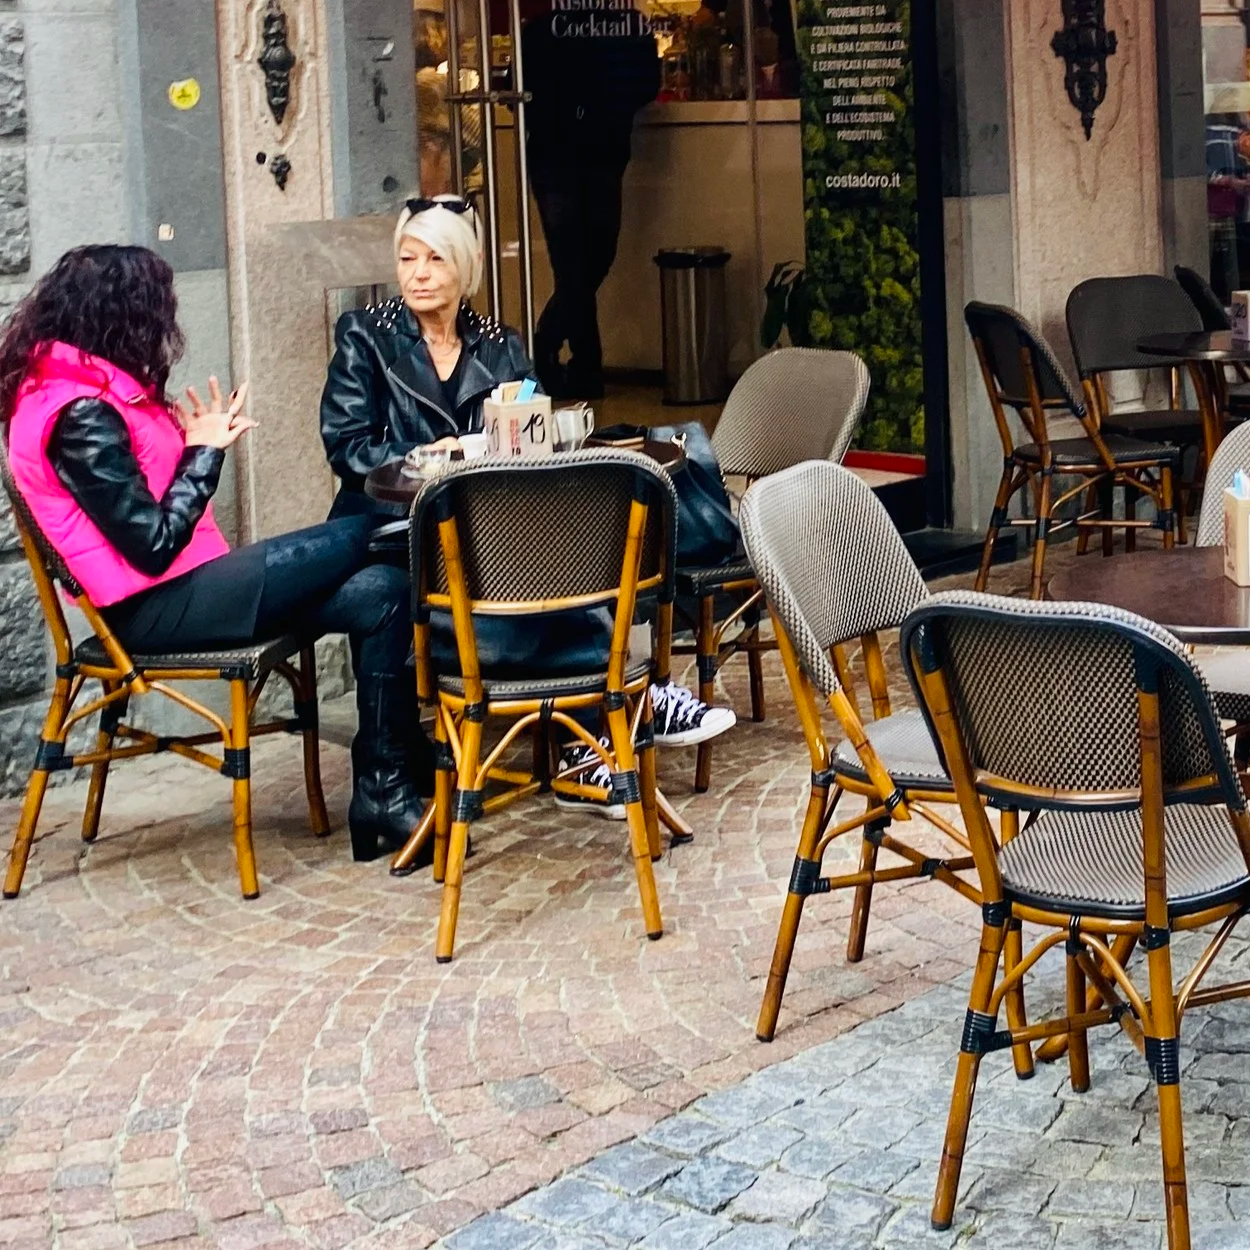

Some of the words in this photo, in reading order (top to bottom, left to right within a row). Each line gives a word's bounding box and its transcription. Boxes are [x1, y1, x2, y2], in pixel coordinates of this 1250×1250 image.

[551, 13, 632, 38] Cocktail
[638, 13, 672, 36] Bar
[825, 172, 901, 188] costadoro.it
[522, 413, 546, 444] 19
